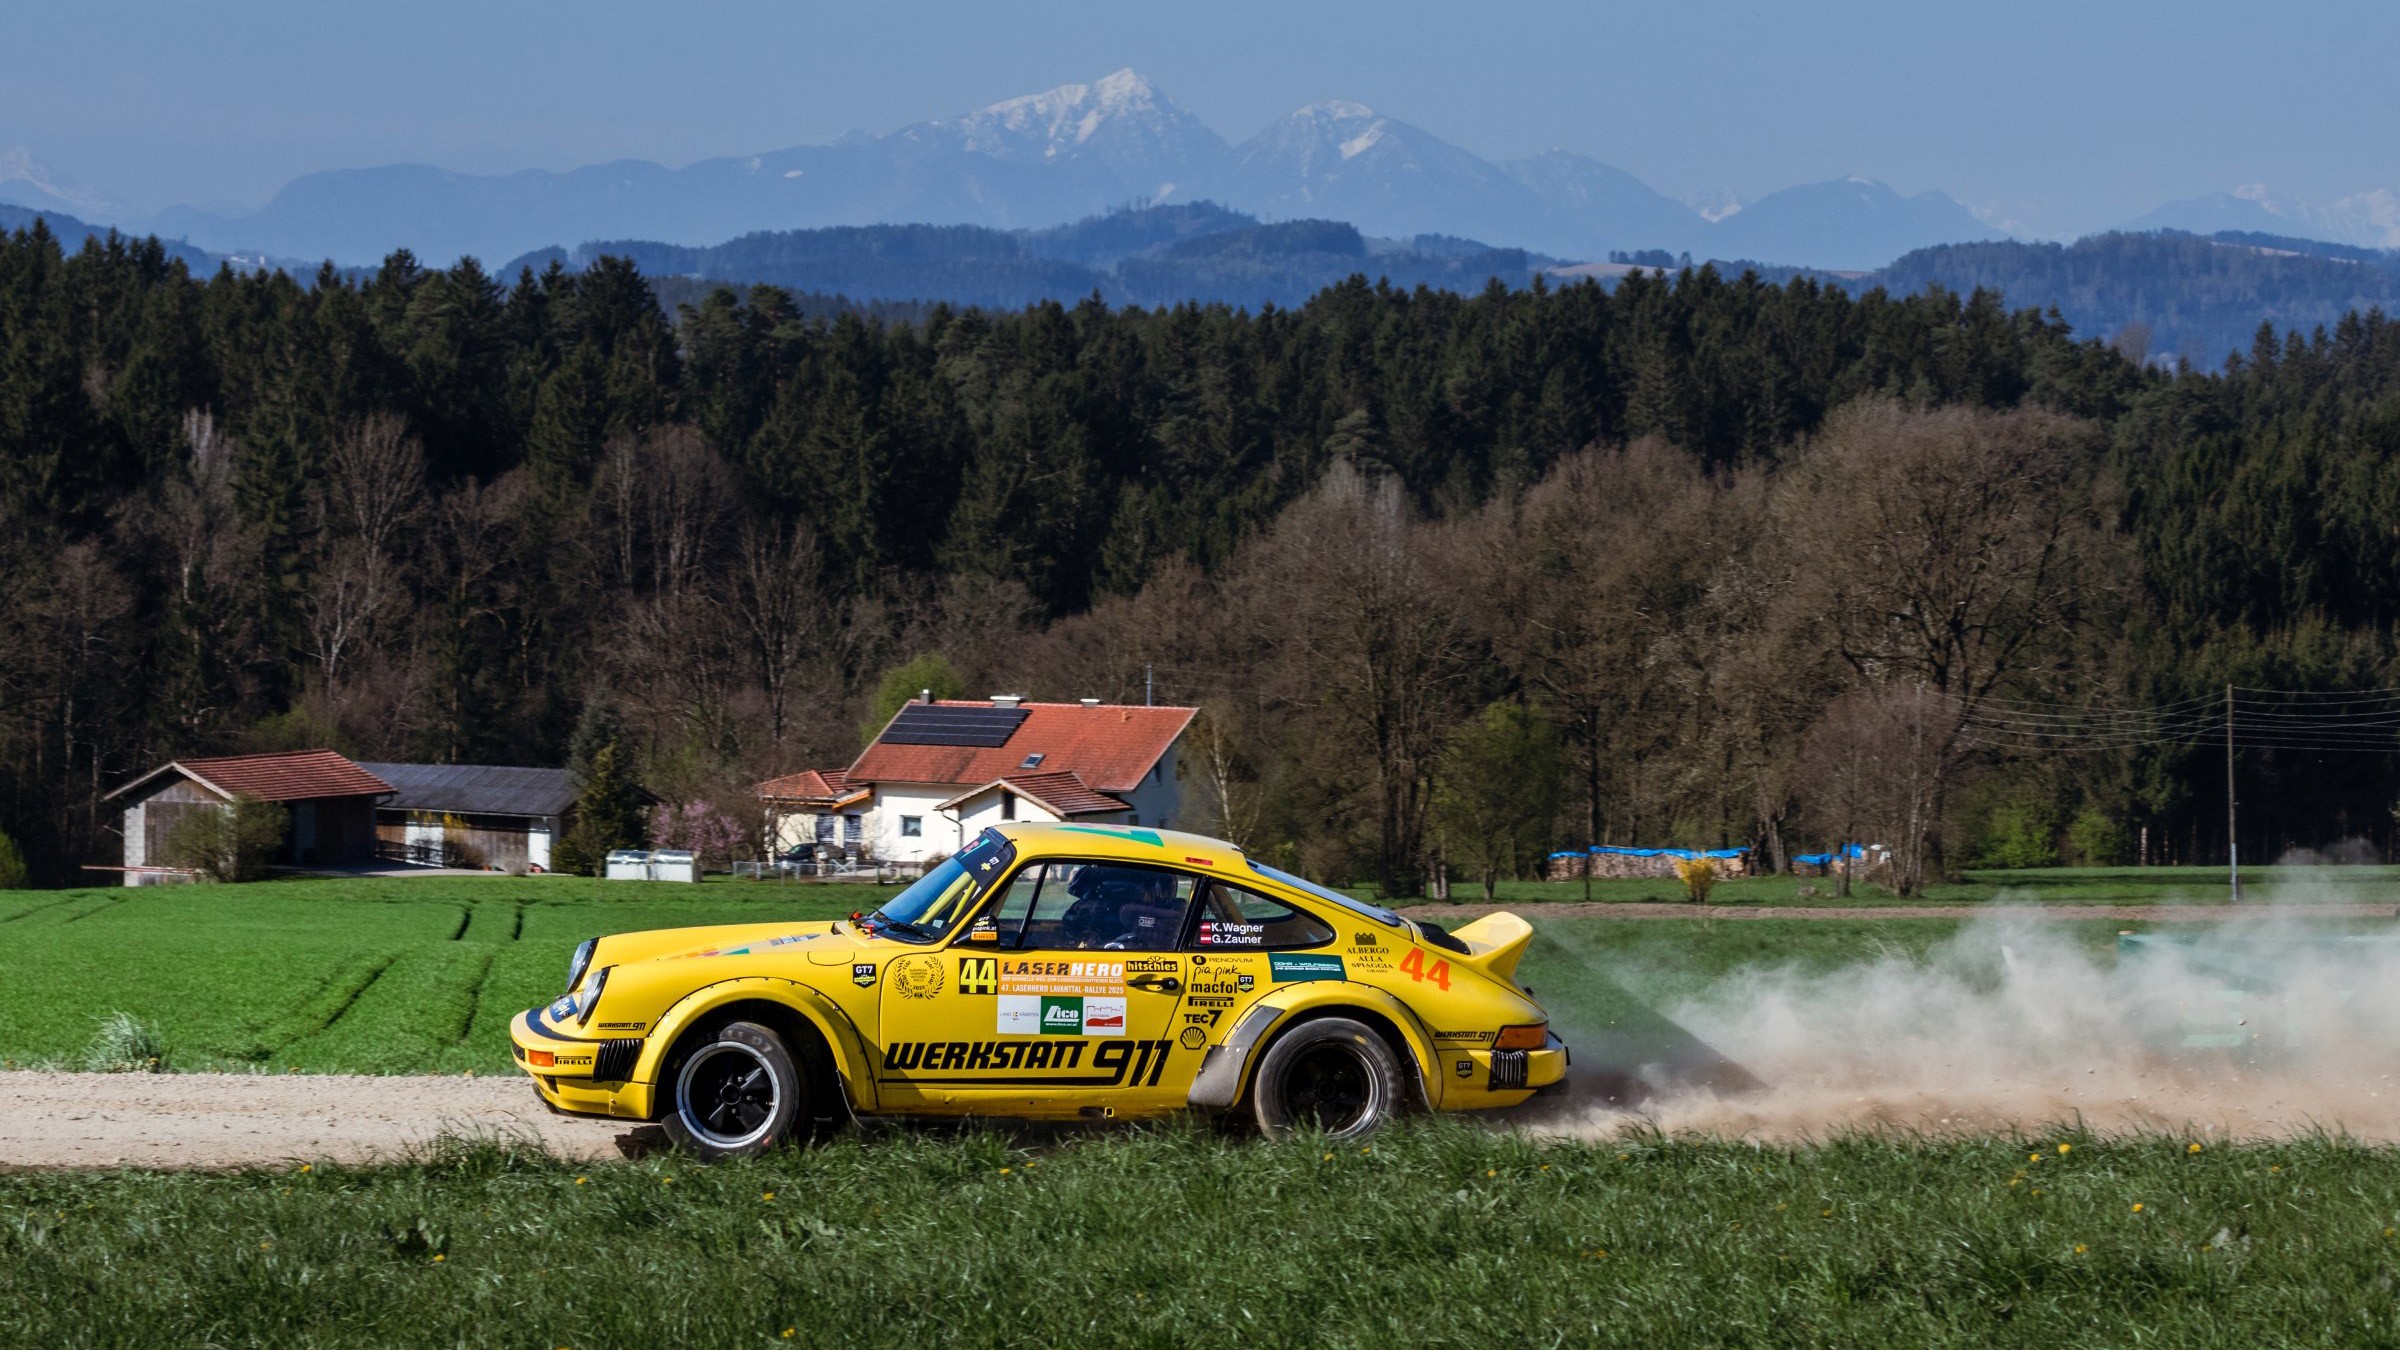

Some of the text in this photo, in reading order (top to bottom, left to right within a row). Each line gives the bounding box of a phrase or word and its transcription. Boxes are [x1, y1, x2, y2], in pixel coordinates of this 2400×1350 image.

[855, 965, 873, 974] GT7
[1127, 961, 1177, 971] hitschies
[1400, 947, 1452, 992] 44
[960, 958, 998, 994] 44
[1012, 984, 1048, 993] LASERHERO
[1050, 985, 1106, 994] LAVANTTAL-RALLYE
[1108, 986, 1124, 994] 2025
[1191, 981, 1238, 994] macfol
[1188, 996, 1235, 1007] PIRELLI
[632, 1022, 646, 1031] 911
[1478, 1031, 1496, 1042] 911
[555, 1055, 592, 1065] PIRELLI
[883, 1040, 1174, 1087] WERKSTATT 911
